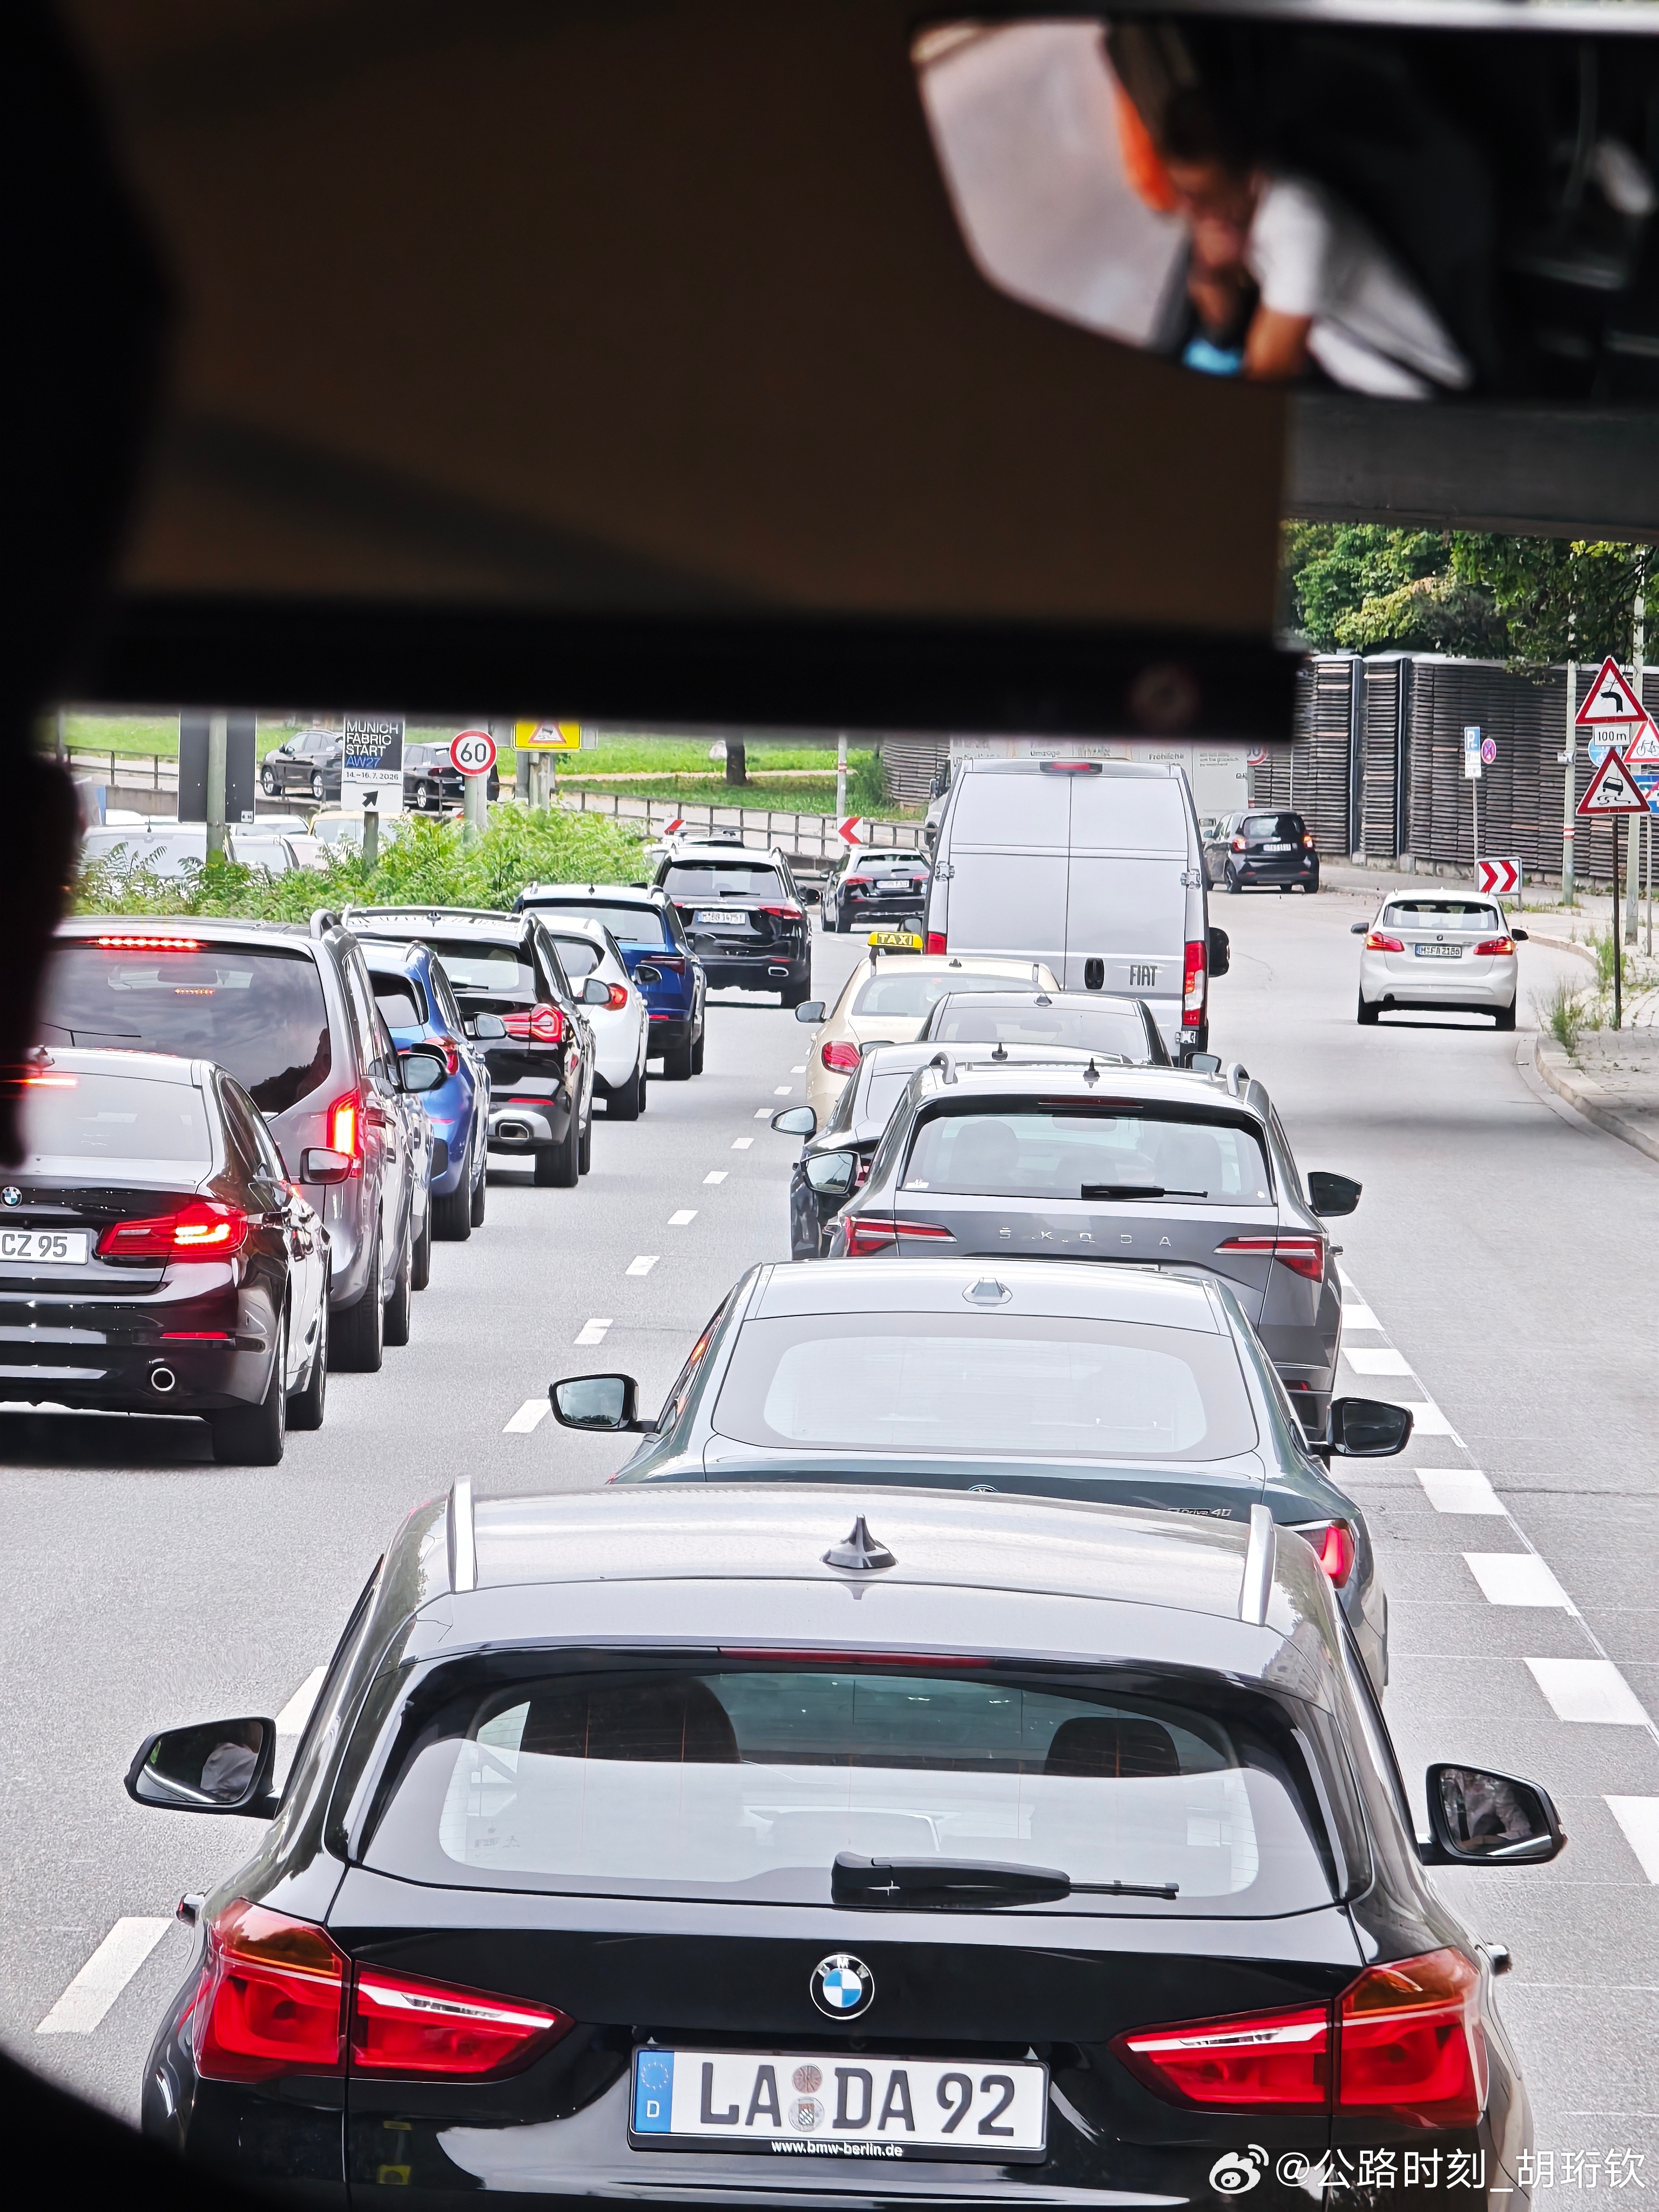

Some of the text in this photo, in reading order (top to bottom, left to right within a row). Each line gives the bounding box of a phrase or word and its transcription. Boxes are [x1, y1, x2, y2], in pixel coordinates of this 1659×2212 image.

[346, 719, 399, 734] MUNICH
[346, 732, 392, 745] FABRIC
[1467, 731, 1475, 749] P
[1599, 731, 1627, 741] 100 m
[346, 744, 387, 757] START
[461, 743, 487, 763] 60
[346, 756, 381, 767] AW27
[878, 934, 913, 946] TAXI
[1130, 965, 1157, 986] FIAT
[2, 1233, 68, 1258] CZ 95
[700, 2062, 1015, 2136] LA DA 92
[646, 2100, 660, 2118] D
[771, 2140, 903, 2157] www.bmw-berlin.de
